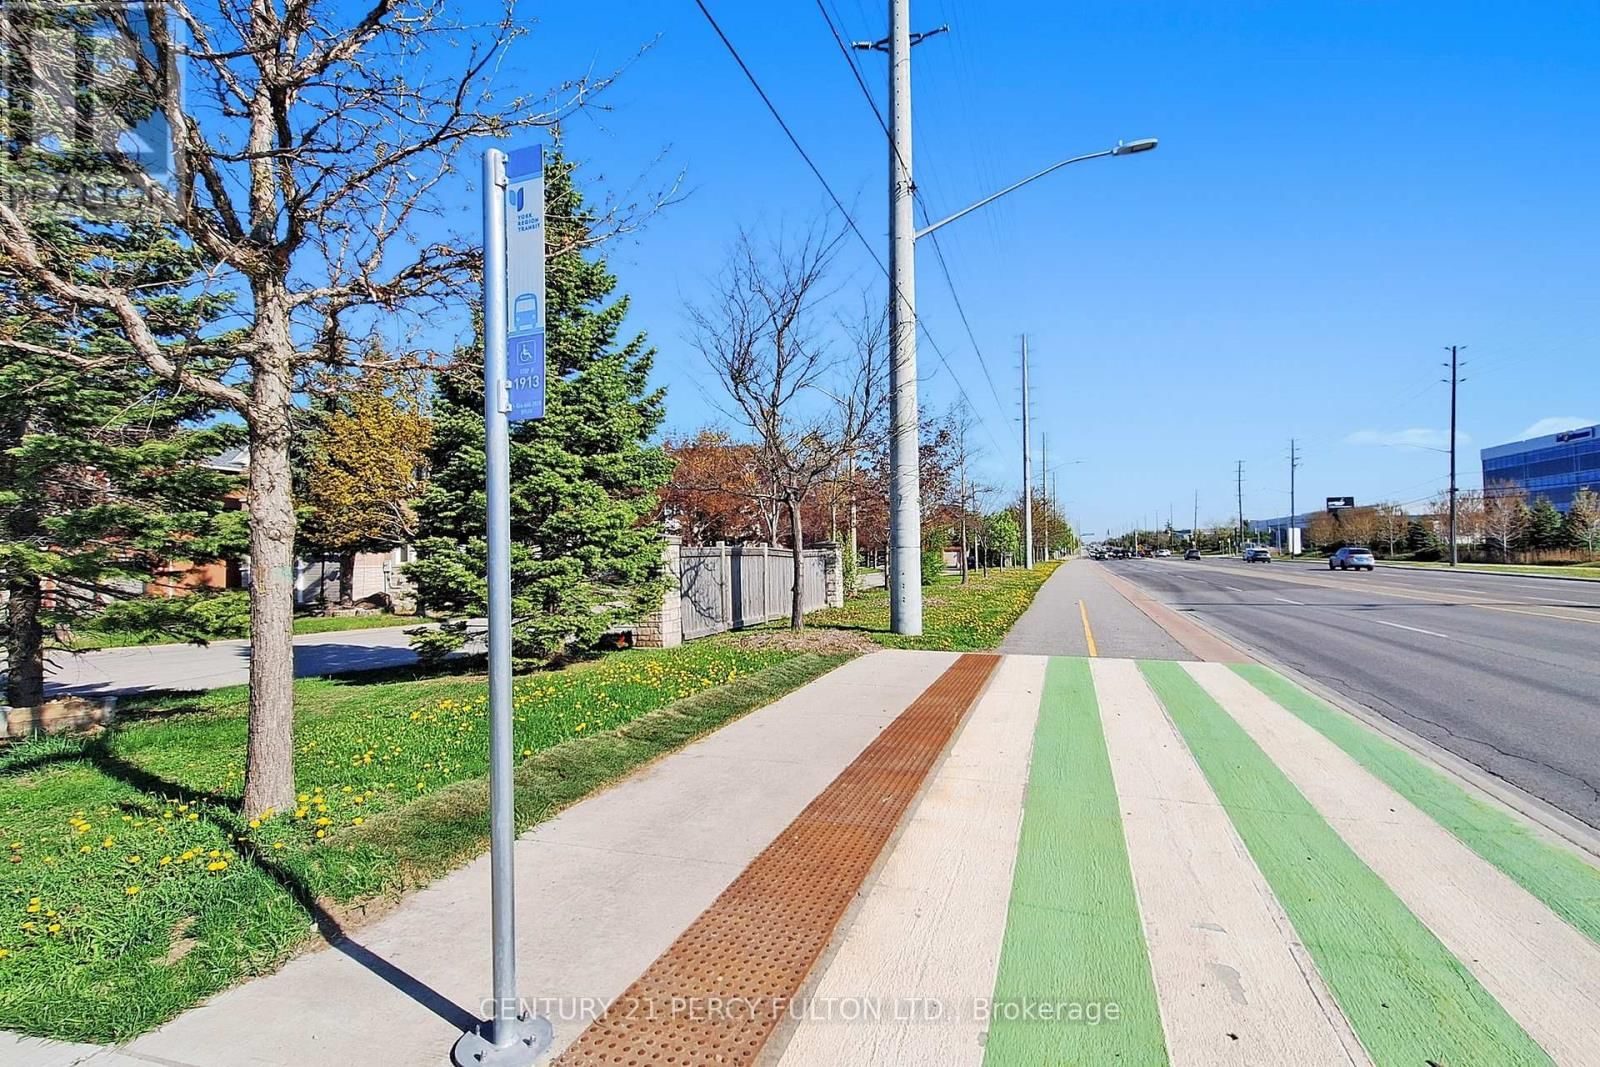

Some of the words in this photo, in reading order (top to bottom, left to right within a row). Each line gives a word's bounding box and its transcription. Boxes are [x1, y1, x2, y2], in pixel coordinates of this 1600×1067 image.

[517, 217, 539, 226] REGION
[517, 222, 541, 232] TRANSIT
[514, 375, 540, 390] 1913
